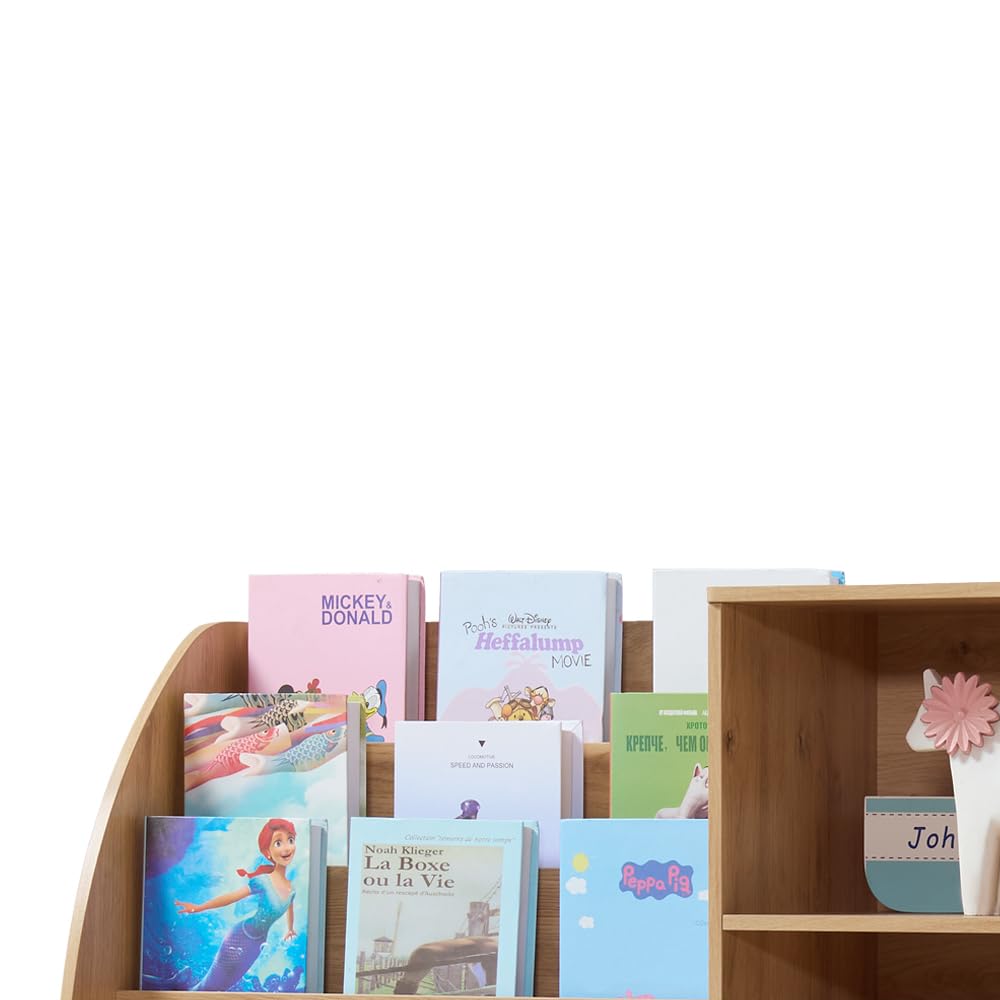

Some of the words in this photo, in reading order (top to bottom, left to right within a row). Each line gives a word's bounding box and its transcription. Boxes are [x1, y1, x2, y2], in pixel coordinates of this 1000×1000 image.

[321, 610, 393, 625] DONALD
[463, 615, 498, 635] Pooh's
[474, 632, 584, 654] Heffalump
[551, 653, 592, 669] MOVIE
[676, 735, 697, 752] ЧЕМ
[450, 761, 472, 769] SPEED
[364, 845, 398, 855] Noah
[401, 845, 445, 857] Klieger
[364, 856, 391, 870] La
[399, 856, 450, 872] Boxe
[363, 875, 389, 887] ou
[396, 873, 413, 887] la
[421, 874, 455, 889] Vie
[623, 865, 666, 896] Peppa
[668, 865, 692, 896] Pig
